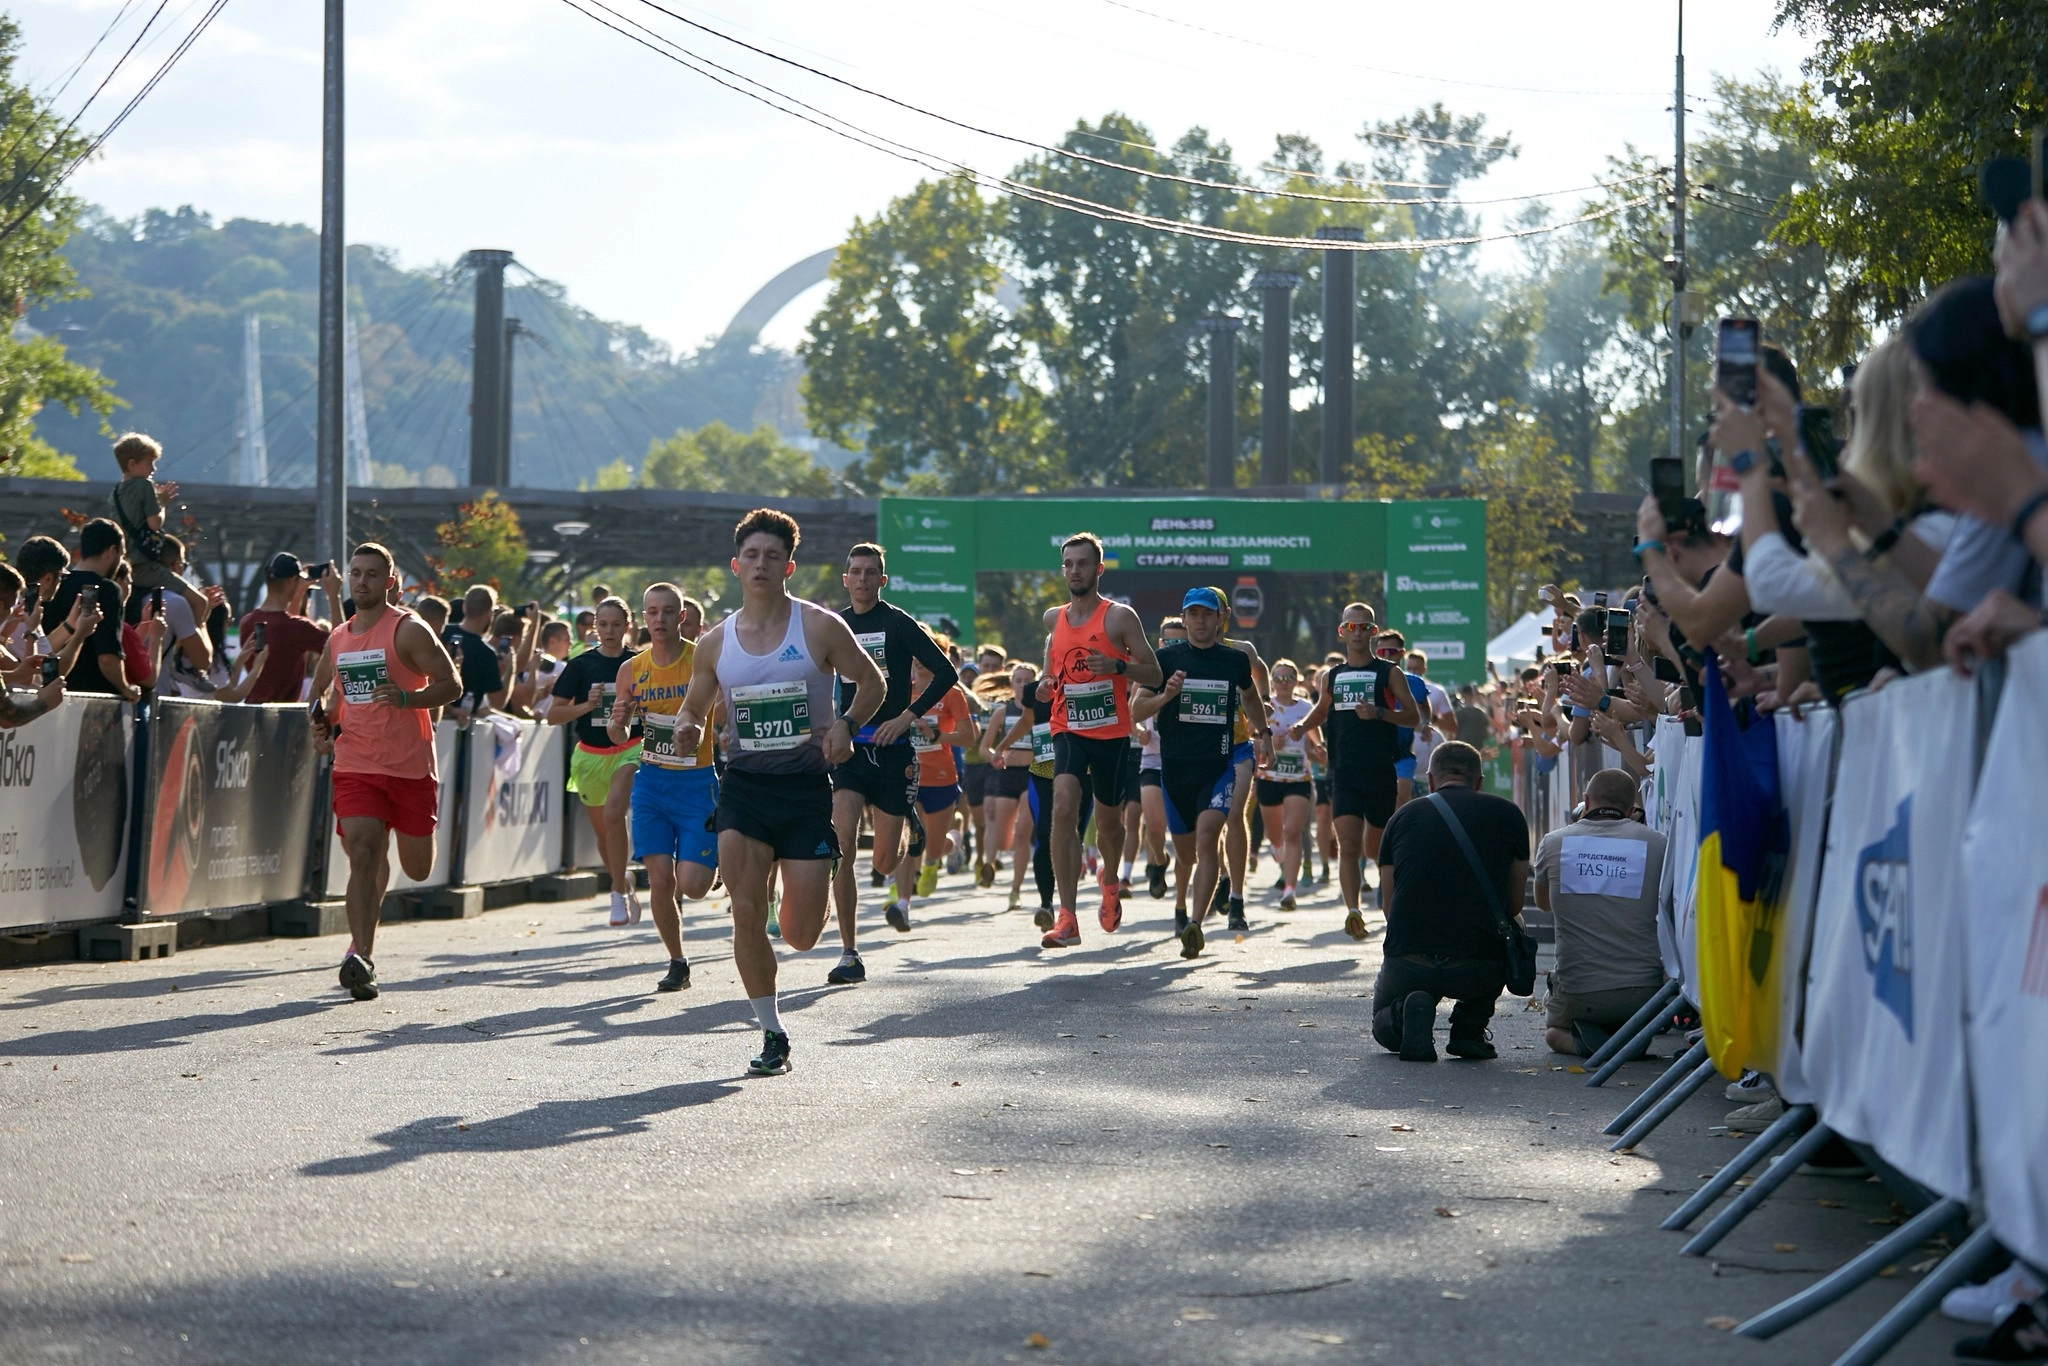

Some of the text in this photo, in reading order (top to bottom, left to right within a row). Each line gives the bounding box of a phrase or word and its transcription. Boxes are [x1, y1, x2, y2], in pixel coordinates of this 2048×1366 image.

[1134, 536, 1207, 548] МАРАФОН
[1211, 536, 1311, 548] НЕЗЛАМНОСТІ
[1136, 554, 1271, 566] СТАРТ/ФІНІШ 2023
[352, 680, 377, 694] 5021
[1343, 692, 1365, 702] 5912
[1078, 707, 1105, 721] 6100
[1192, 703, 1216, 715] 5961
[753, 720, 793, 738] 5970
[655, 741, 675, 755] 609
[215, 737, 250, 788] Ябко
[1277, 764, 1296, 773] 5717
[1578, 853, 1627, 863] ПРЕДСТАВНИК
[1576, 862, 1604, 877] TAS
